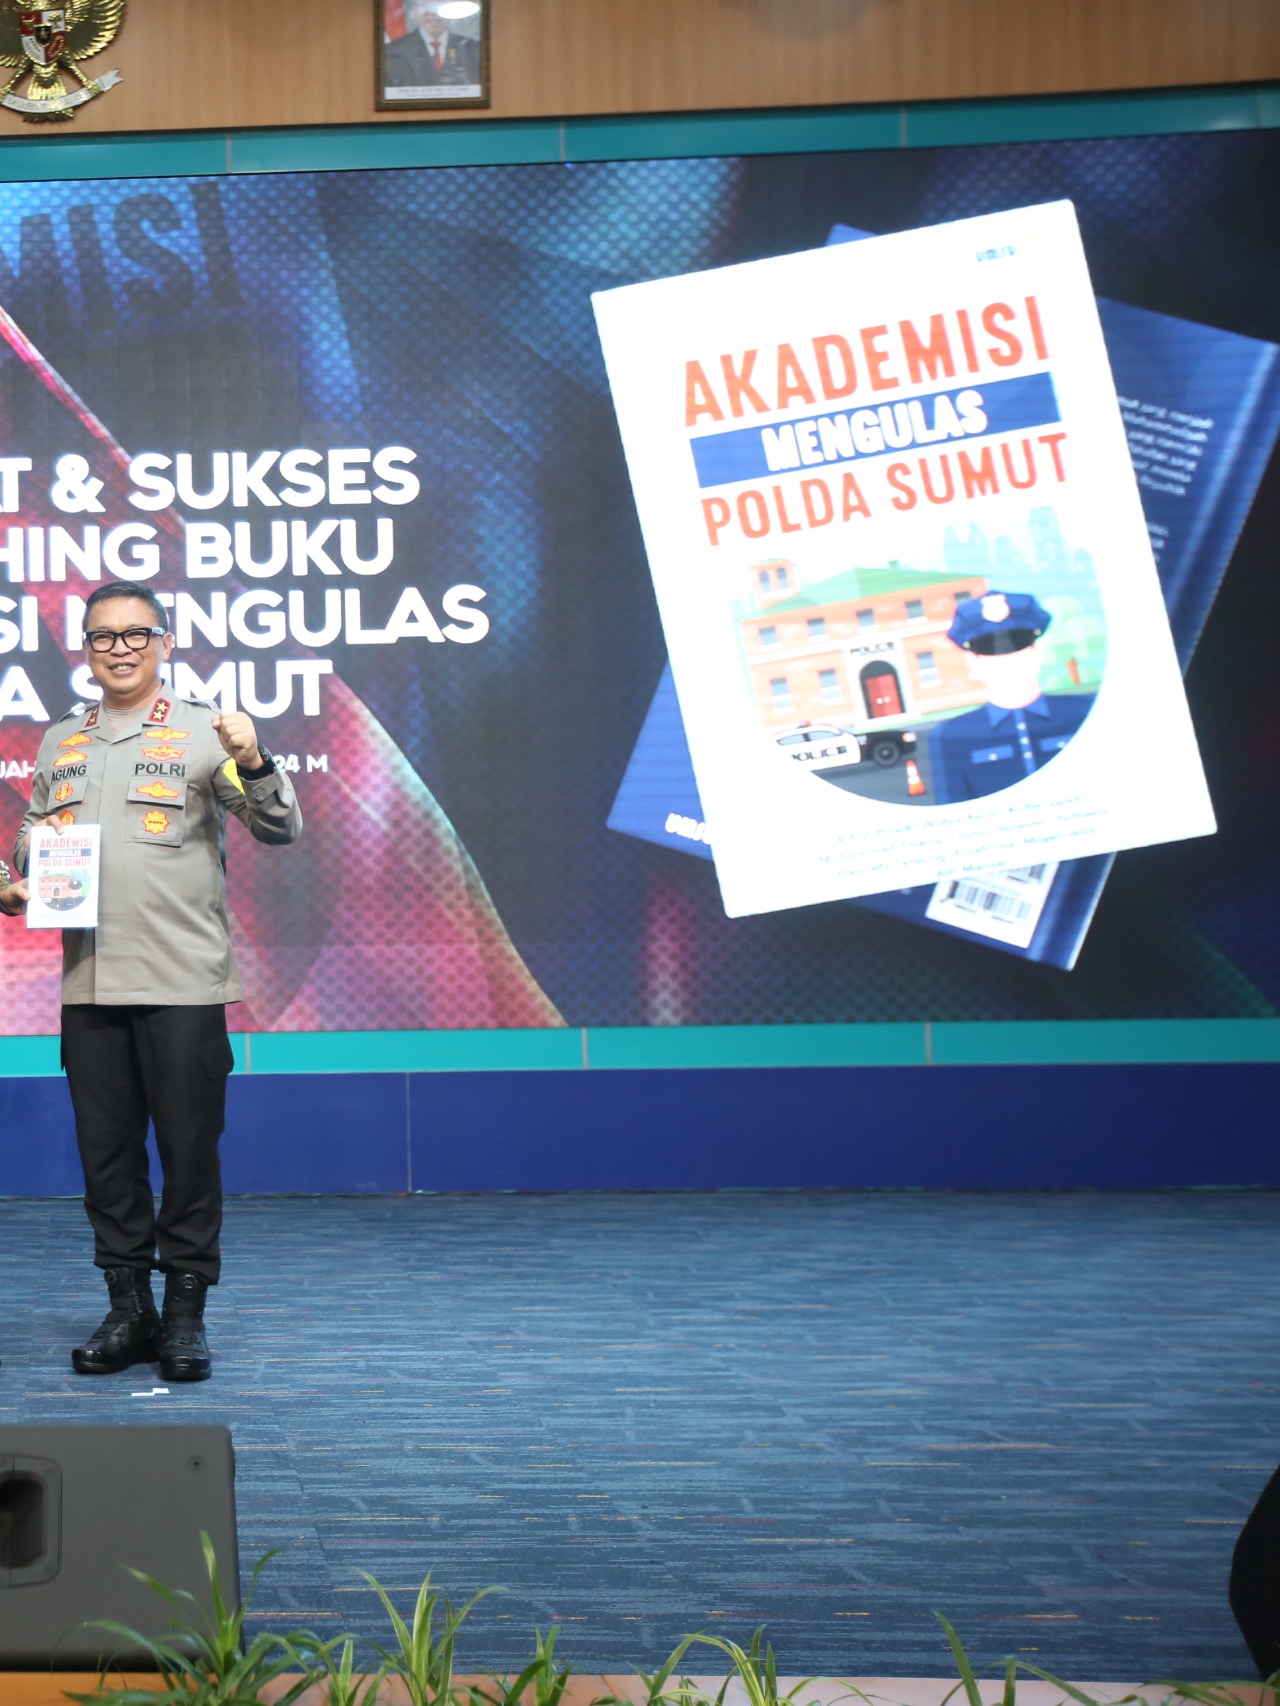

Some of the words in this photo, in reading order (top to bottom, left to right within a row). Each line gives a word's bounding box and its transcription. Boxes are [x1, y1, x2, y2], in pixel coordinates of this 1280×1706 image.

[683, 295, 1050, 427] AKADEMISI
[760, 389, 988, 473] MENGULAS
[51, 453, 106, 513] &
[128, 446, 420, 510] SUKSES
[699, 471, 872, 546] POLDA
[886, 432, 1068, 512] SUMUT
[185, 517, 394, 578] BUKU
[51, 764, 87, 785] AGUNG
[135, 763, 186, 778] POLRI
[306, 754, 328, 773] M
[38, 858, 63, 867] POLDA
[65, 858, 92, 867] SUMUT
[40, 837, 93, 849] AKADEMISI
